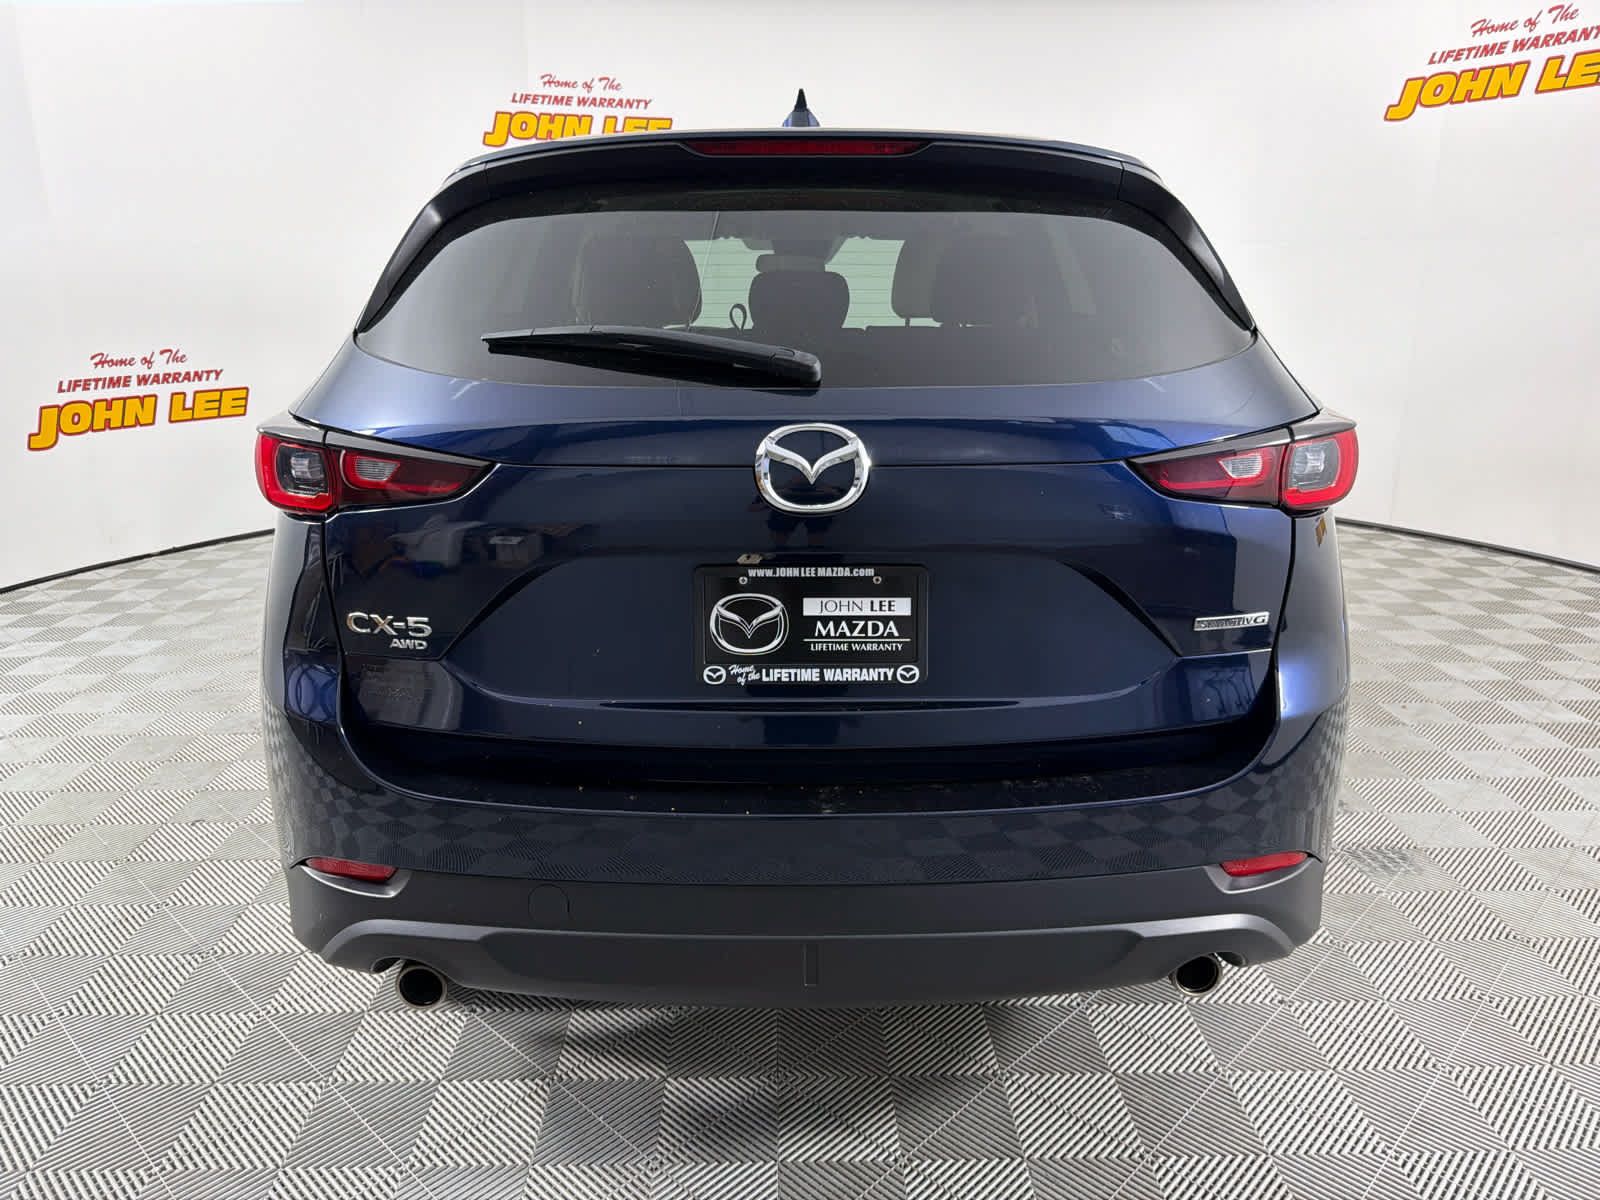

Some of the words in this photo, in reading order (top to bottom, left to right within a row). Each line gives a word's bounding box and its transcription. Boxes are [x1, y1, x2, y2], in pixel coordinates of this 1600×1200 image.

[1470, 18, 1520, 38] Home
[1523, 10, 1543, 32] of
[1548, 3, 1580, 24] The
[1427, 41, 1510, 65] LIFETIME
[540, 74, 578, 88] Home
[582, 78, 594, 93] of
[598, 77, 622, 91] The
[1384, 60, 1531, 121] JOHN
[1535, 49, 1600, 94] LE
[511, 93, 574, 107] LIFETIME
[576, 96, 652, 110] WARRANTY
[483, 111, 593, 147] JOHN
[90, 352, 136, 369] Home
[141, 352, 154, 370] of
[159, 348, 188, 365] The
[57, 375, 132, 394] LIFETIME
[136, 369, 224, 387] WARRANTY
[27, 394, 158, 451] JOHN
[168, 386, 250, 424] LEE
[819, 600, 863, 614] JOHN
[870, 600, 896, 612] LEE
[346, 611, 432, 637] CX-5
[814, 620, 899, 637] MAZDA
[389, 638, 428, 650] AWD
[810, 643, 849, 651] LIFETIME
[851, 643, 903, 651] WARRANTY
[728, 664, 755, 676] Home
[737, 672, 746, 686] of
[747, 671, 760, 681] the
[762, 668, 822, 681] LIFETIME
[823, 668, 894, 681] WARRANTY
